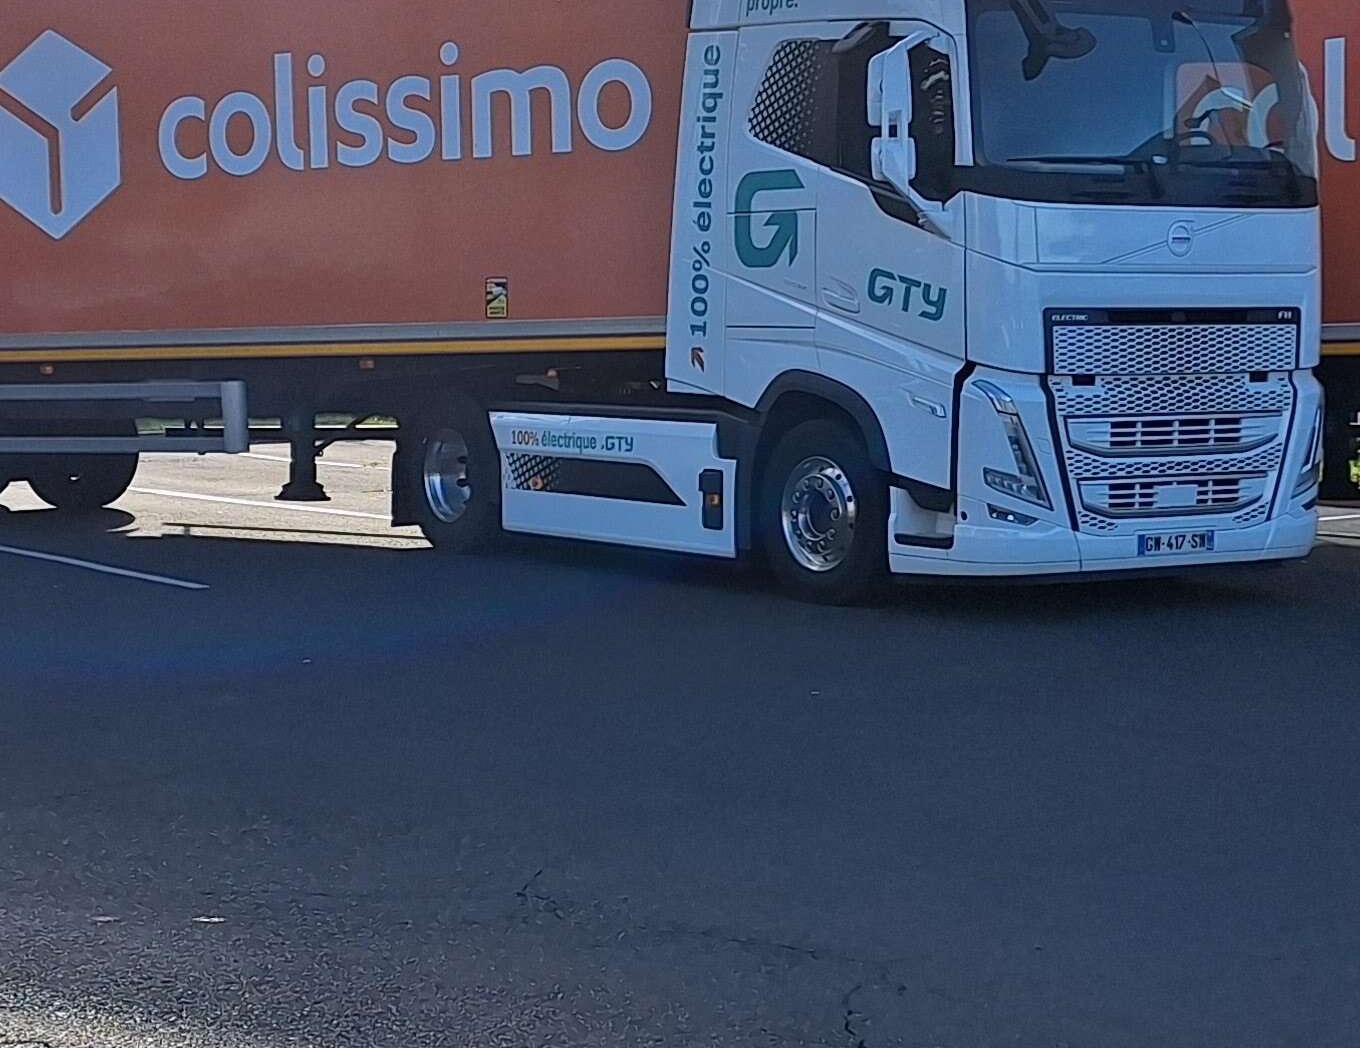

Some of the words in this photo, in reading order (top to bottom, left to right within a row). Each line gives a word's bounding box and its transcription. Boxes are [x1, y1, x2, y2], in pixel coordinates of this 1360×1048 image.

[158, 42, 653, 180] colissimo
[693, 44, 723, 232] électrique
[691, 241, 711, 337] 100%
[867, 268, 947, 321] GTY
[511, 430, 539, 446] 100%
[541, 430, 597, 454] électrique
